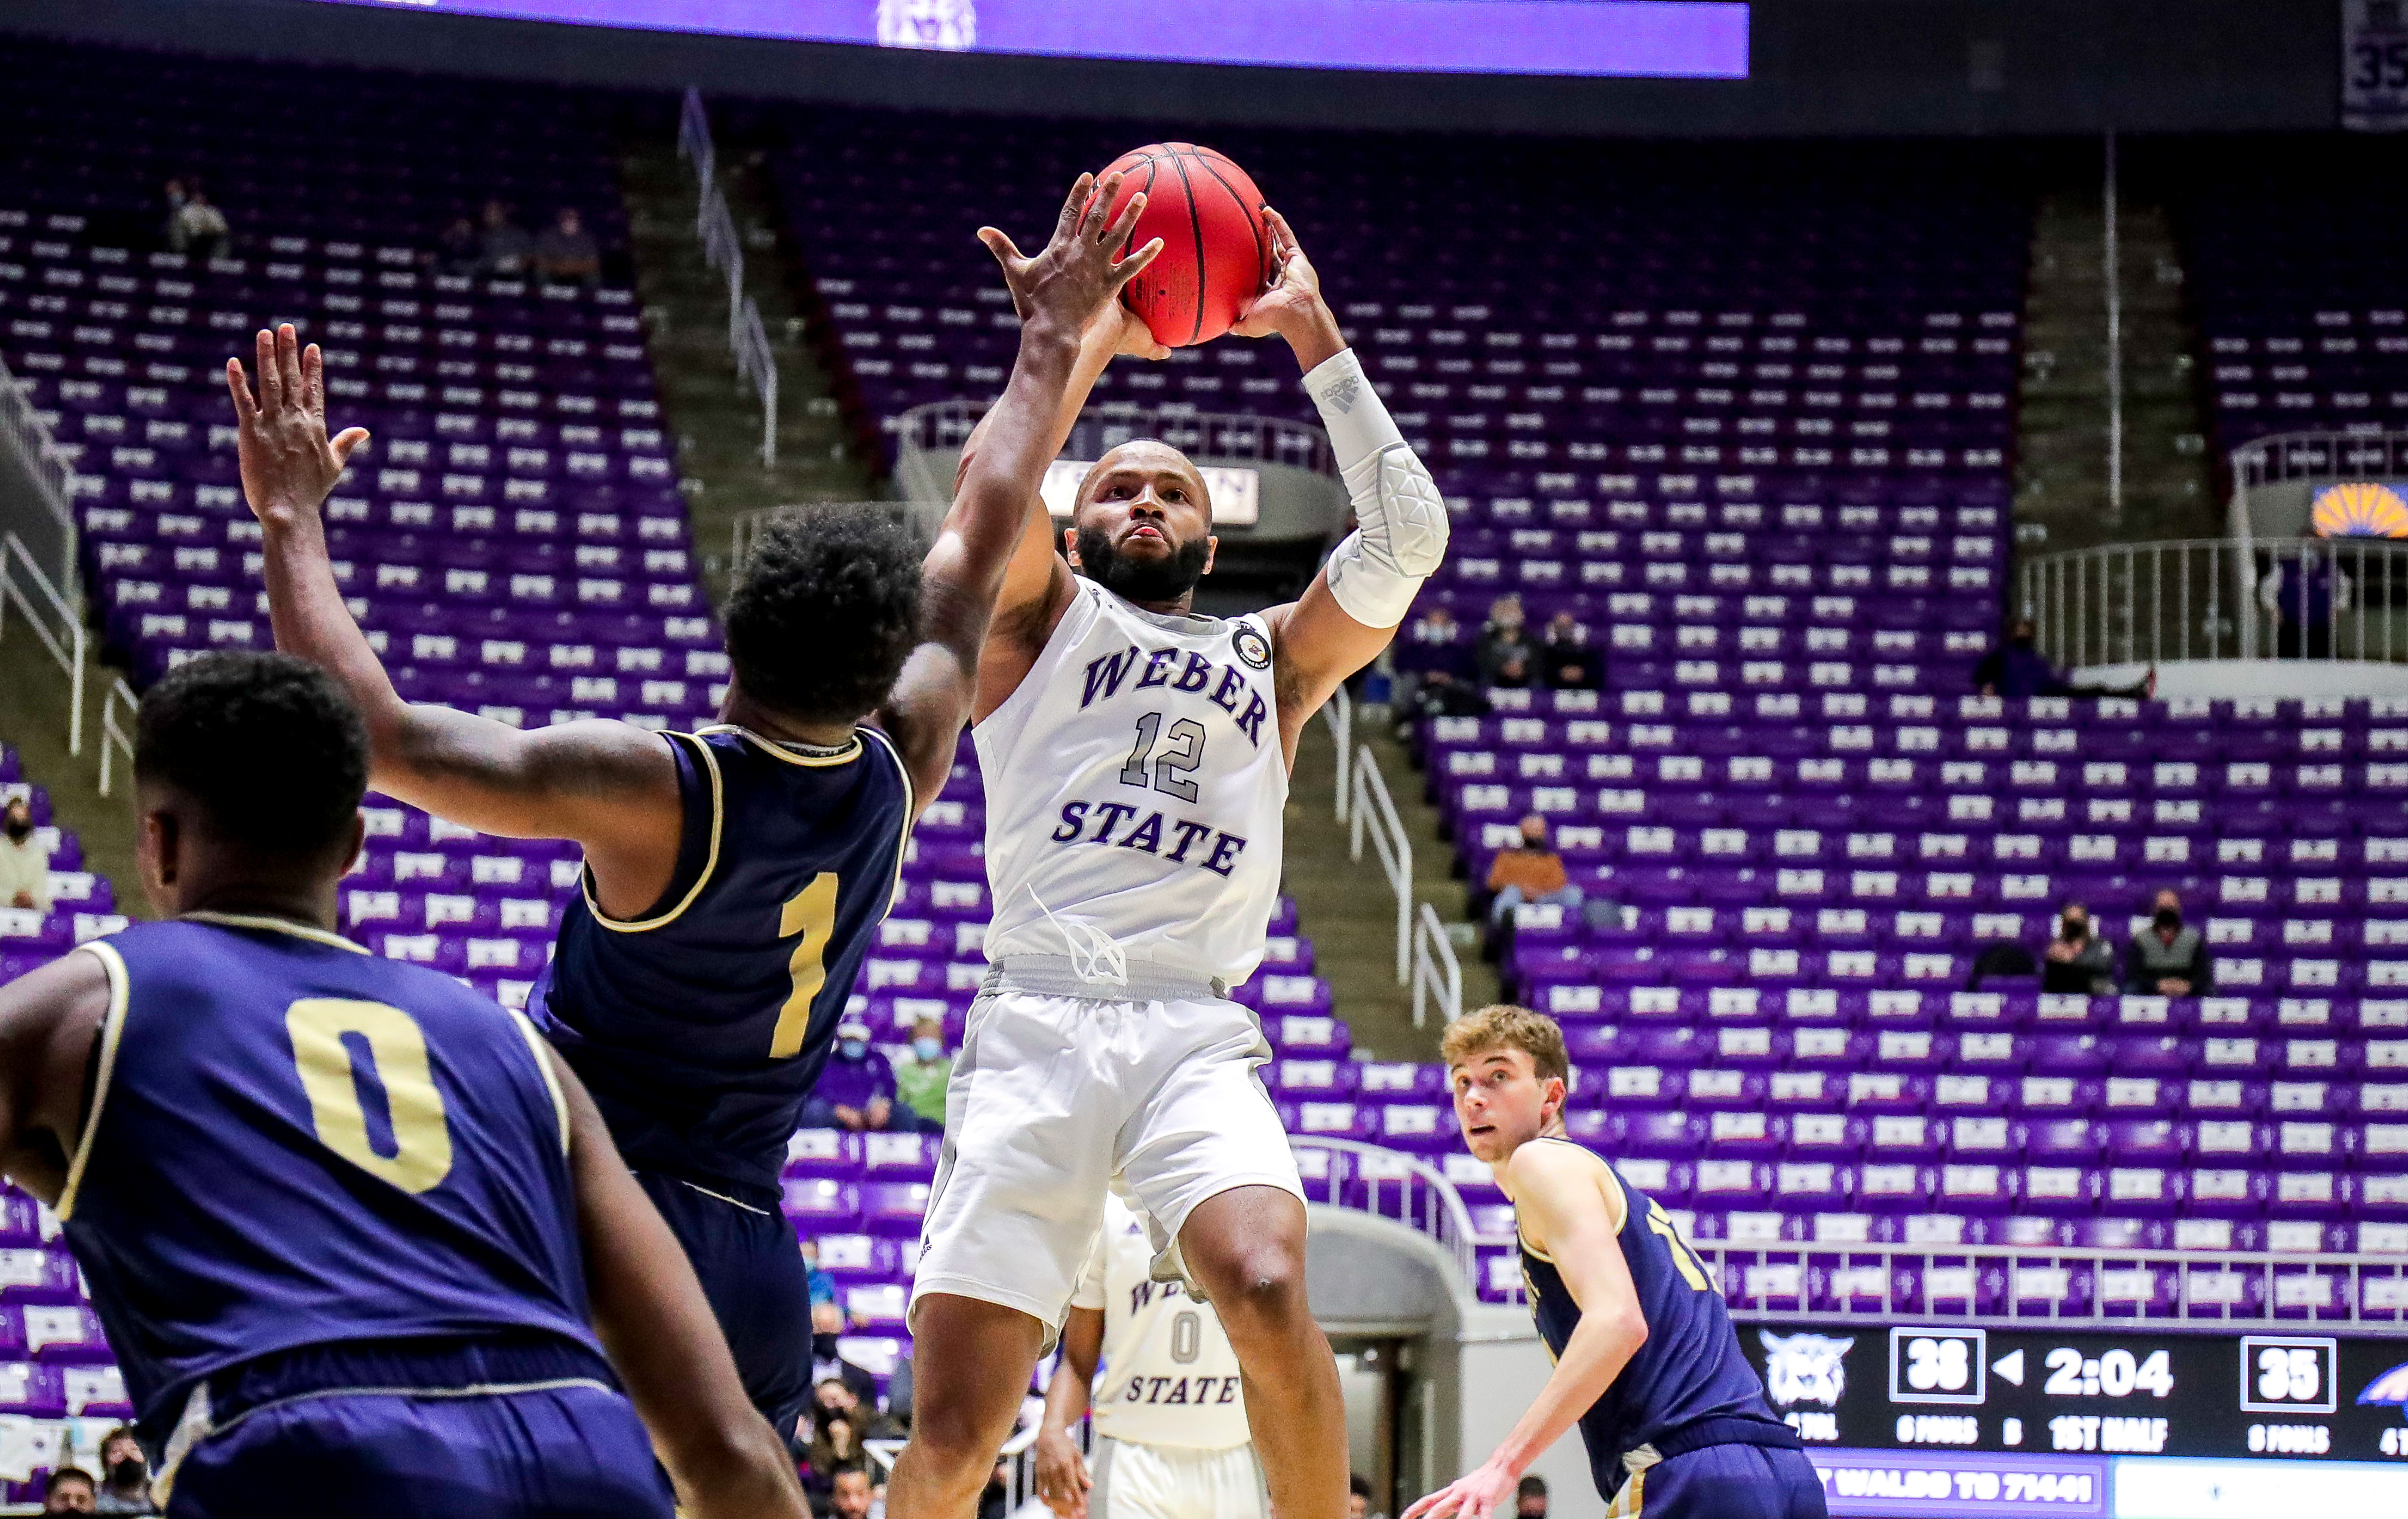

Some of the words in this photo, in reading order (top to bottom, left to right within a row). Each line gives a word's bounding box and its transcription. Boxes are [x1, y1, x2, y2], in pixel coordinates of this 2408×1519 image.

[2351, 41, 2408, 89] 35
[1320, 375, 1359, 400] adidas
[1078, 644, 1268, 752] WEBER
[1119, 712, 1206, 804] 12
[1051, 799, 1248, 879] STATE
[769, 872, 839, 1058] 1
[286, 999, 453, 1194] 0
[1171, 1309, 1203, 1365] 0
[1907, 1337, 1969, 1391] 38
[1126, 1376, 1240, 1404] STATE
[2044, 1347, 2175, 1398] 2:04
[2258, 1348, 2320, 1401] 35
[1953, 1472, 2000, 1500] TO
[2002, 1472, 2092, 1503] 71441
